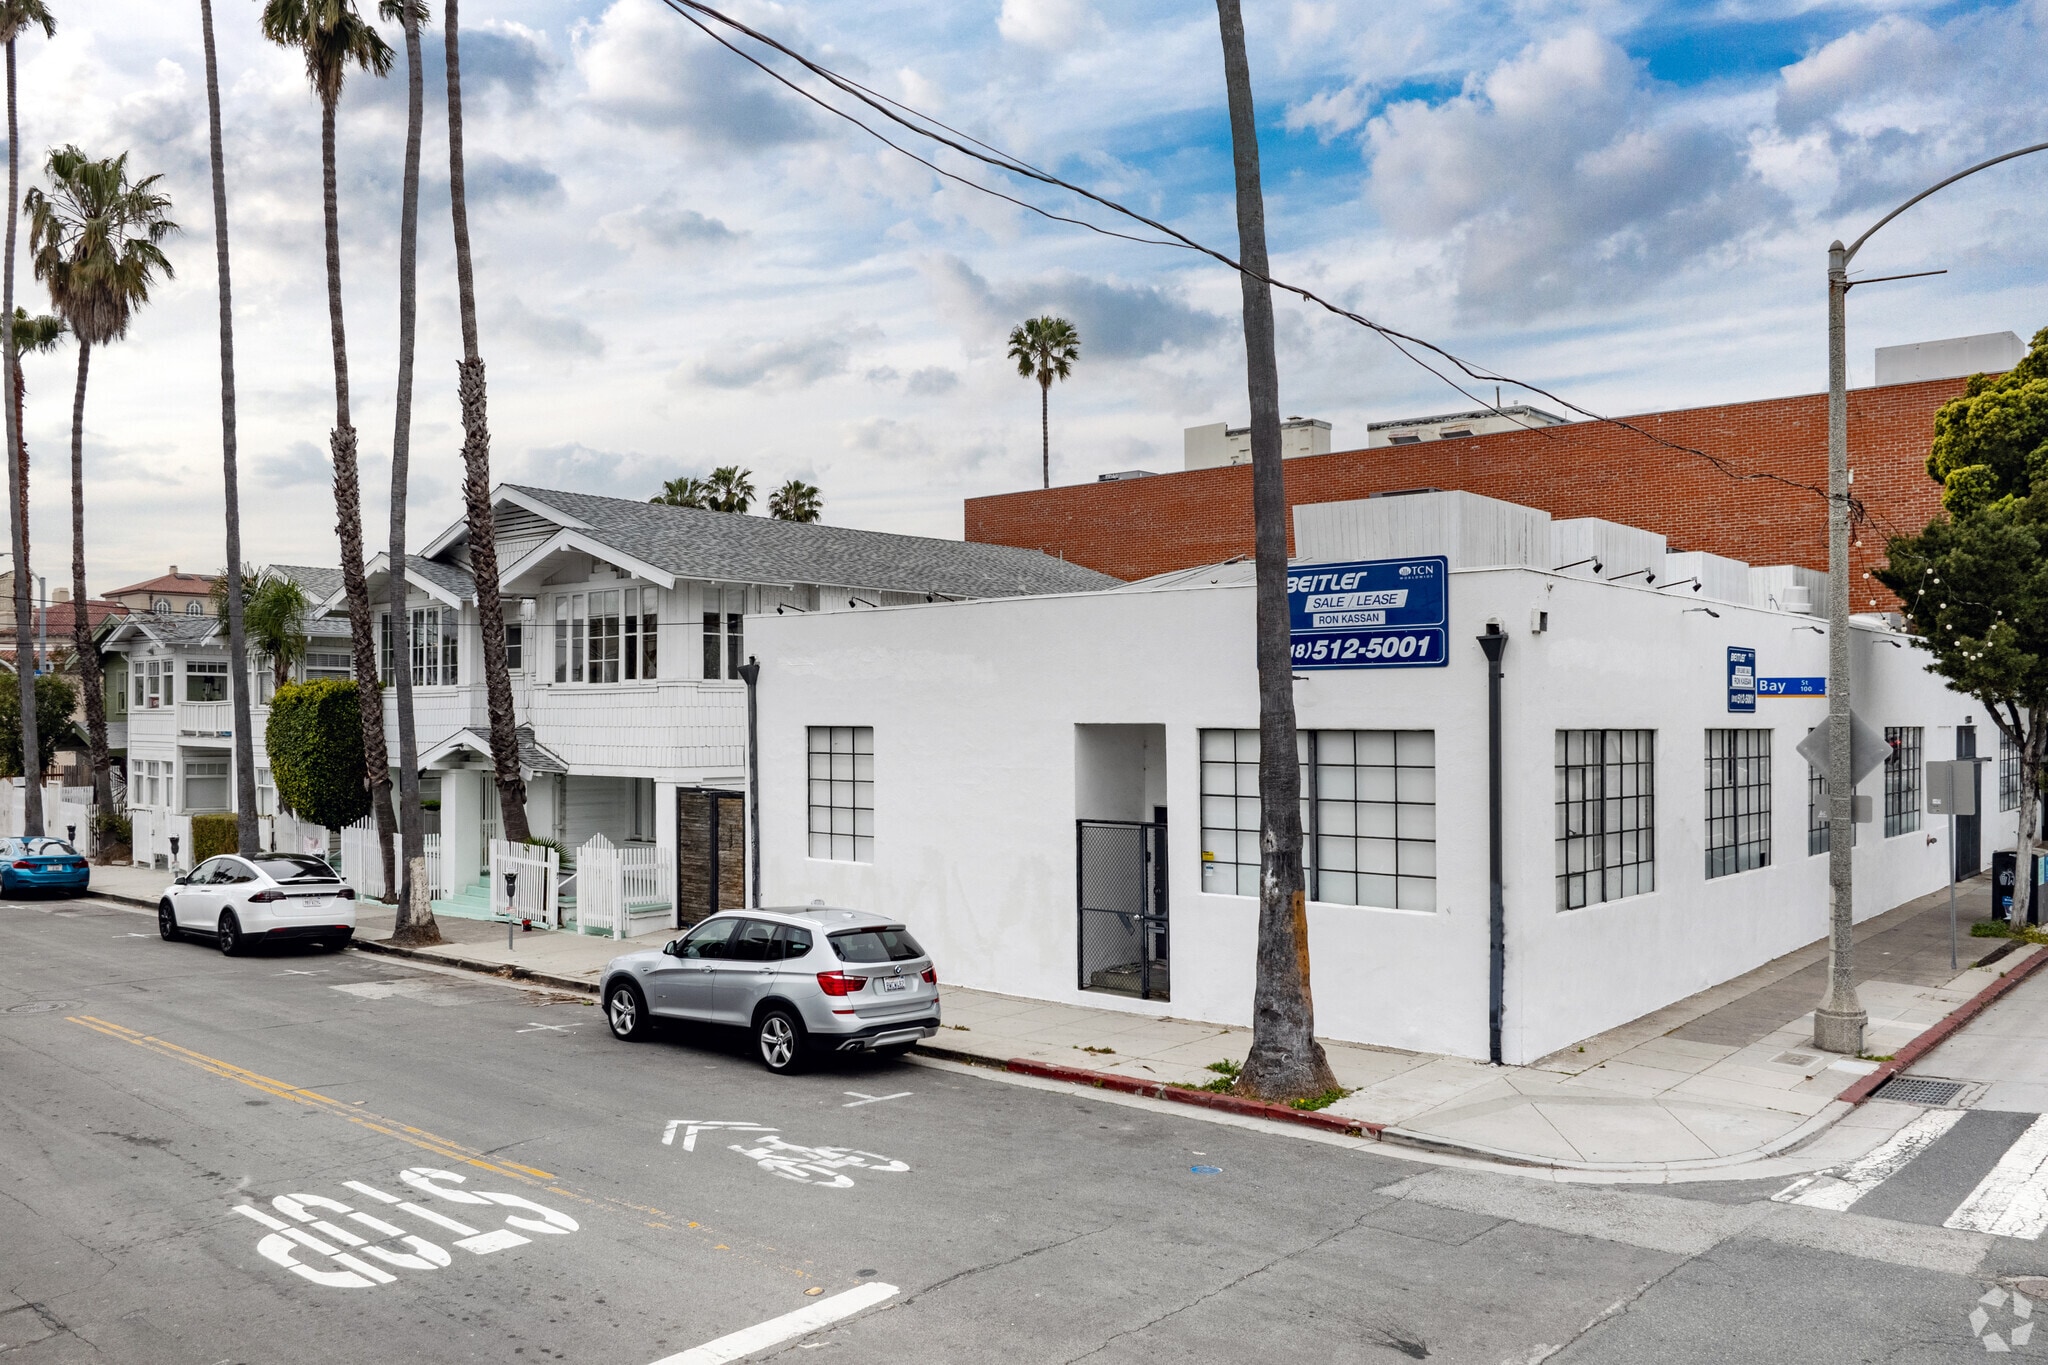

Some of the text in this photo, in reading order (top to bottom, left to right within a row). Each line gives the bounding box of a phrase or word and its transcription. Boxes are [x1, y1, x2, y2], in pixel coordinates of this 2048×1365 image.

[1411, 565, 1434, 575] TCN
[1313, 593, 1398, 608] SALE / LEASE
[1319, 613, 1379, 625] RON KASSAN
[1759, 680, 1786, 694] Bay
[231, 1167, 580, 1288] STOP
